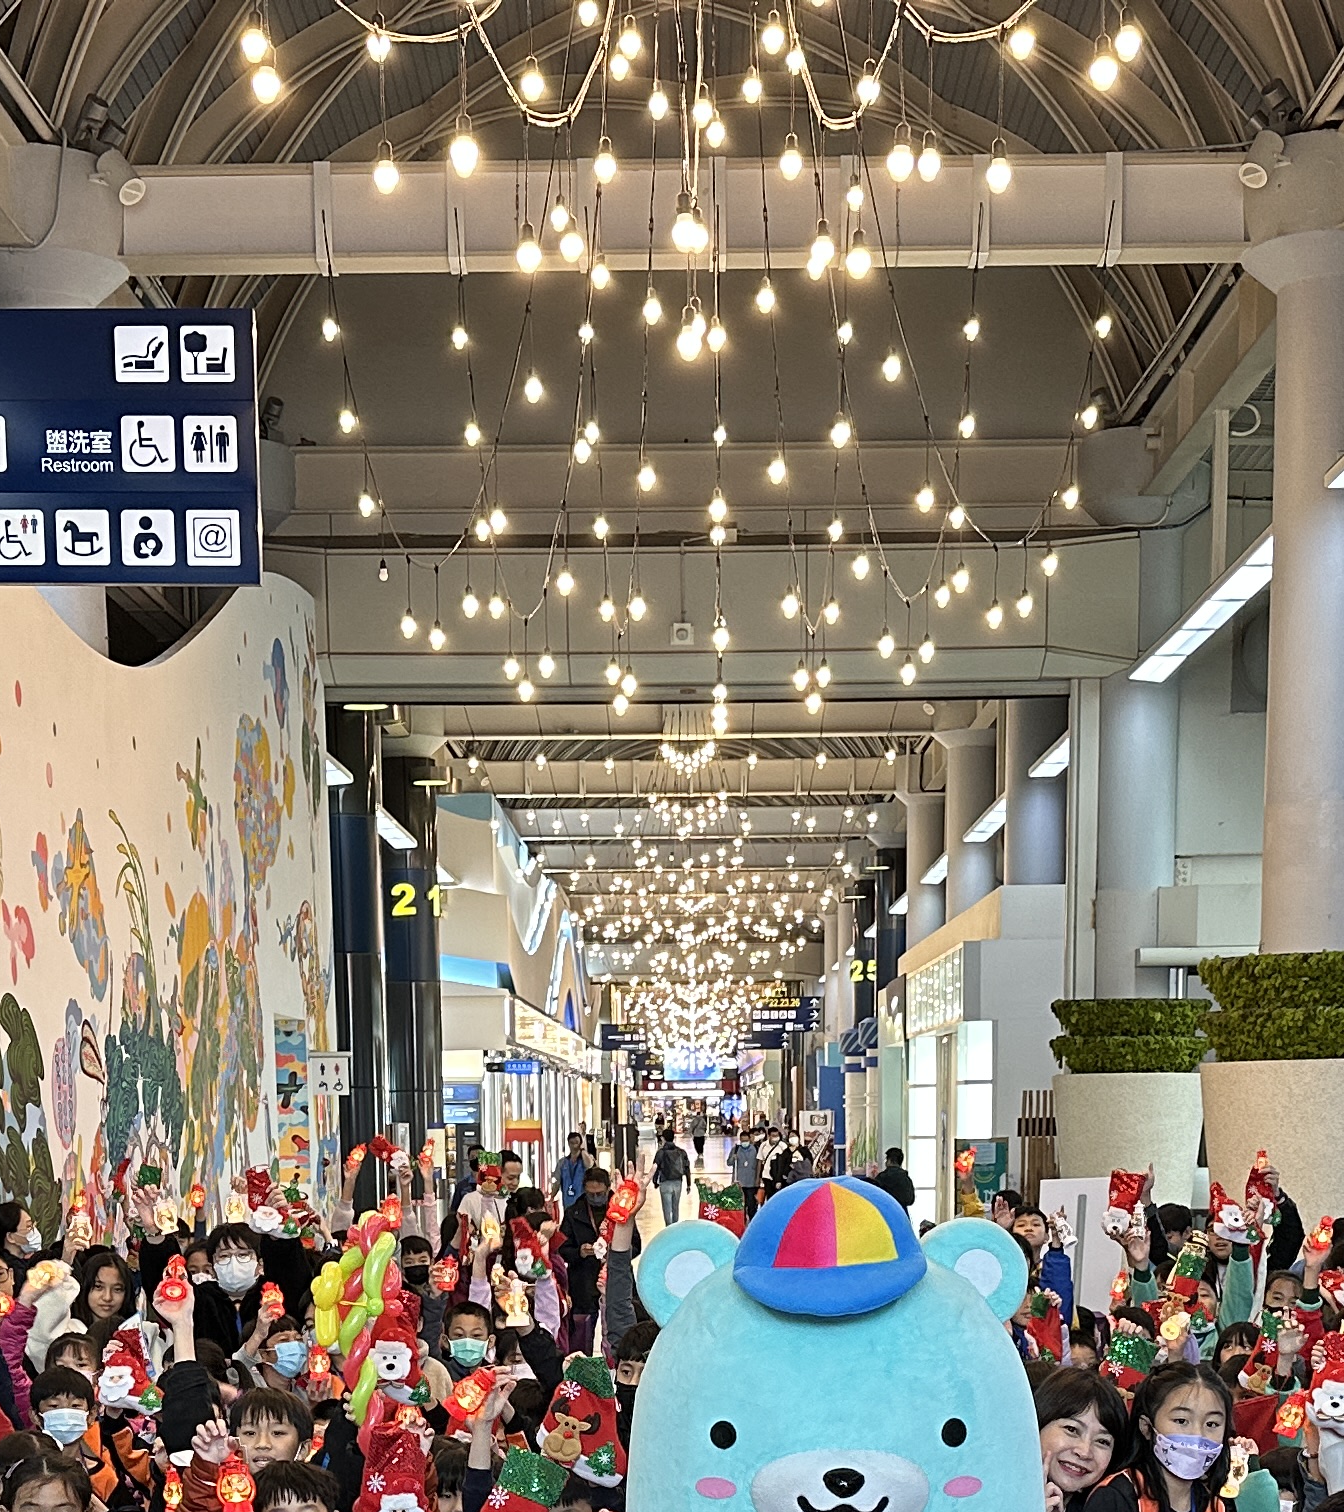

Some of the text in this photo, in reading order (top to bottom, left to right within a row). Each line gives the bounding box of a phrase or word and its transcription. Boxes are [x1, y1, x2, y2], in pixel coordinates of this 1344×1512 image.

[45, 429, 113, 454] 盥洗室
[41, 457, 114, 473] Restroom
[850, 959, 877, 982] 25
